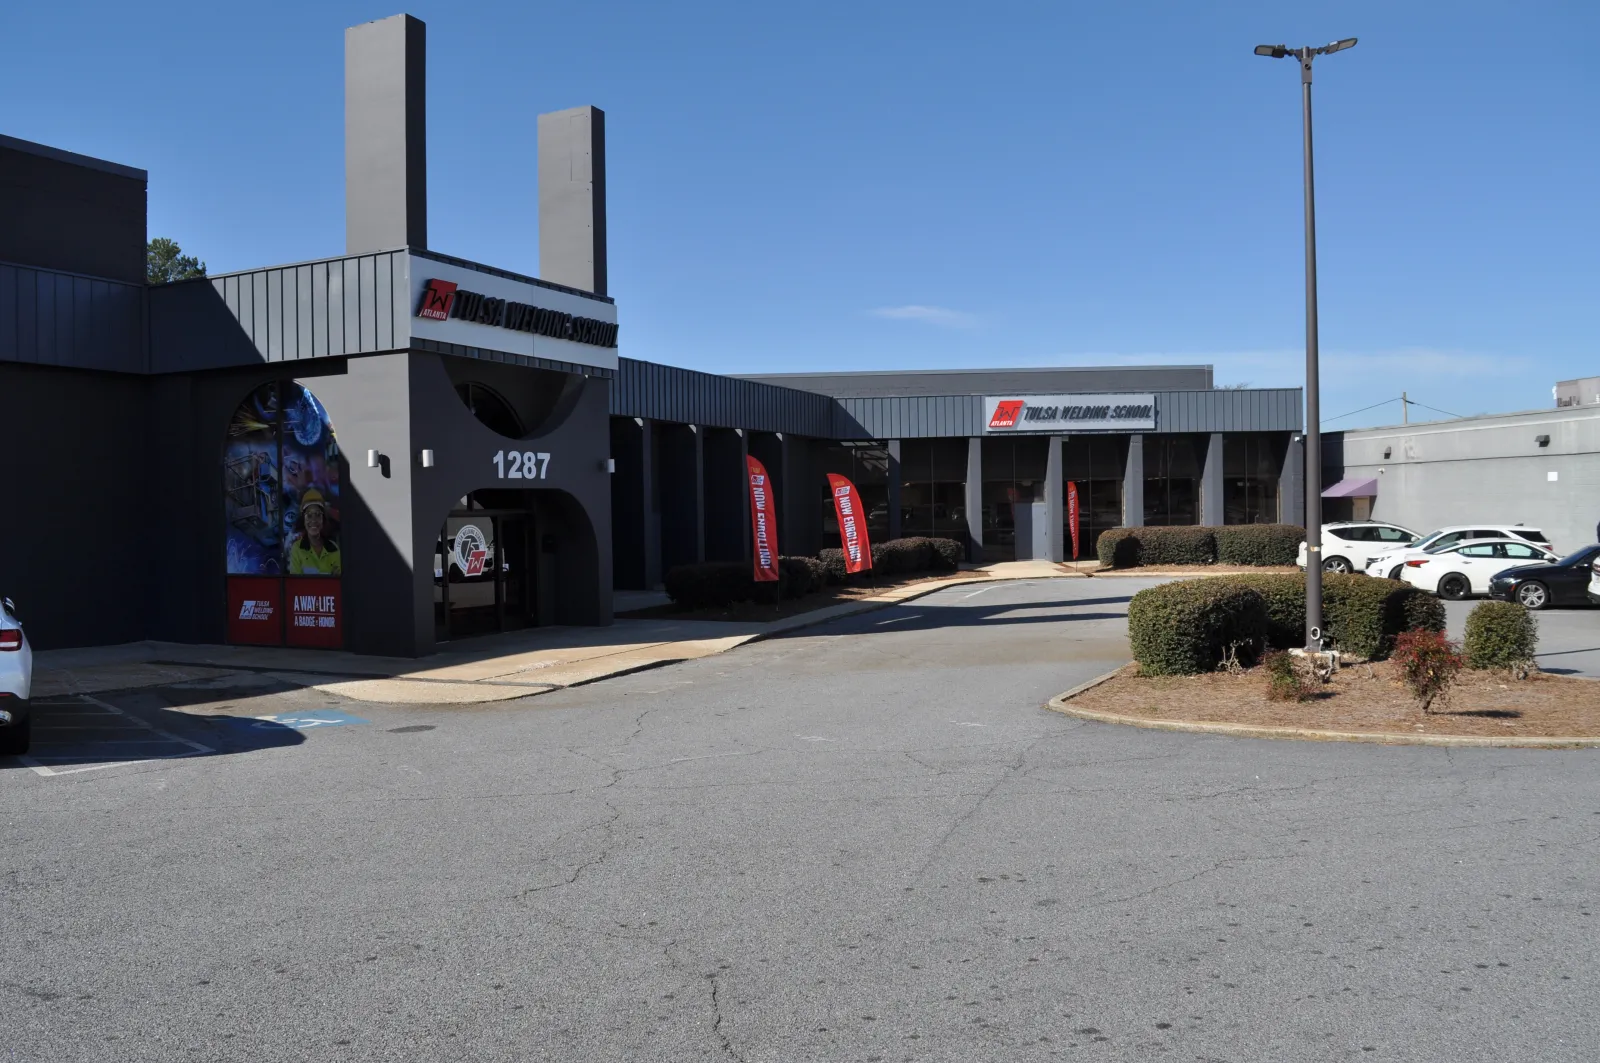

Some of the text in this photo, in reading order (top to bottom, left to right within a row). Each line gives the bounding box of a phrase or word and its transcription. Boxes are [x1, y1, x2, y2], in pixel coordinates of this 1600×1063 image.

[422, 308, 447, 320] ATLANTA
[452, 290, 619, 348] TULSA WELDING SCHOOL
[1023, 404, 1153, 421] TULSA WELDING SCHOOL
[492, 450, 551, 479] 1287
[753, 487, 766, 511] NOW
[839, 496, 853, 515] NOW
[757, 512, 771, 569] ENROLLING!
[843, 515, 862, 563] ENROLLING!
[294, 595, 300, 611] A
[300, 595, 317, 612] WAY
[319, 596, 335, 612] LIFE
[294, 616, 299, 626] A
[299, 616, 316, 627] BADGE
[318, 616, 335, 628] HONOR
